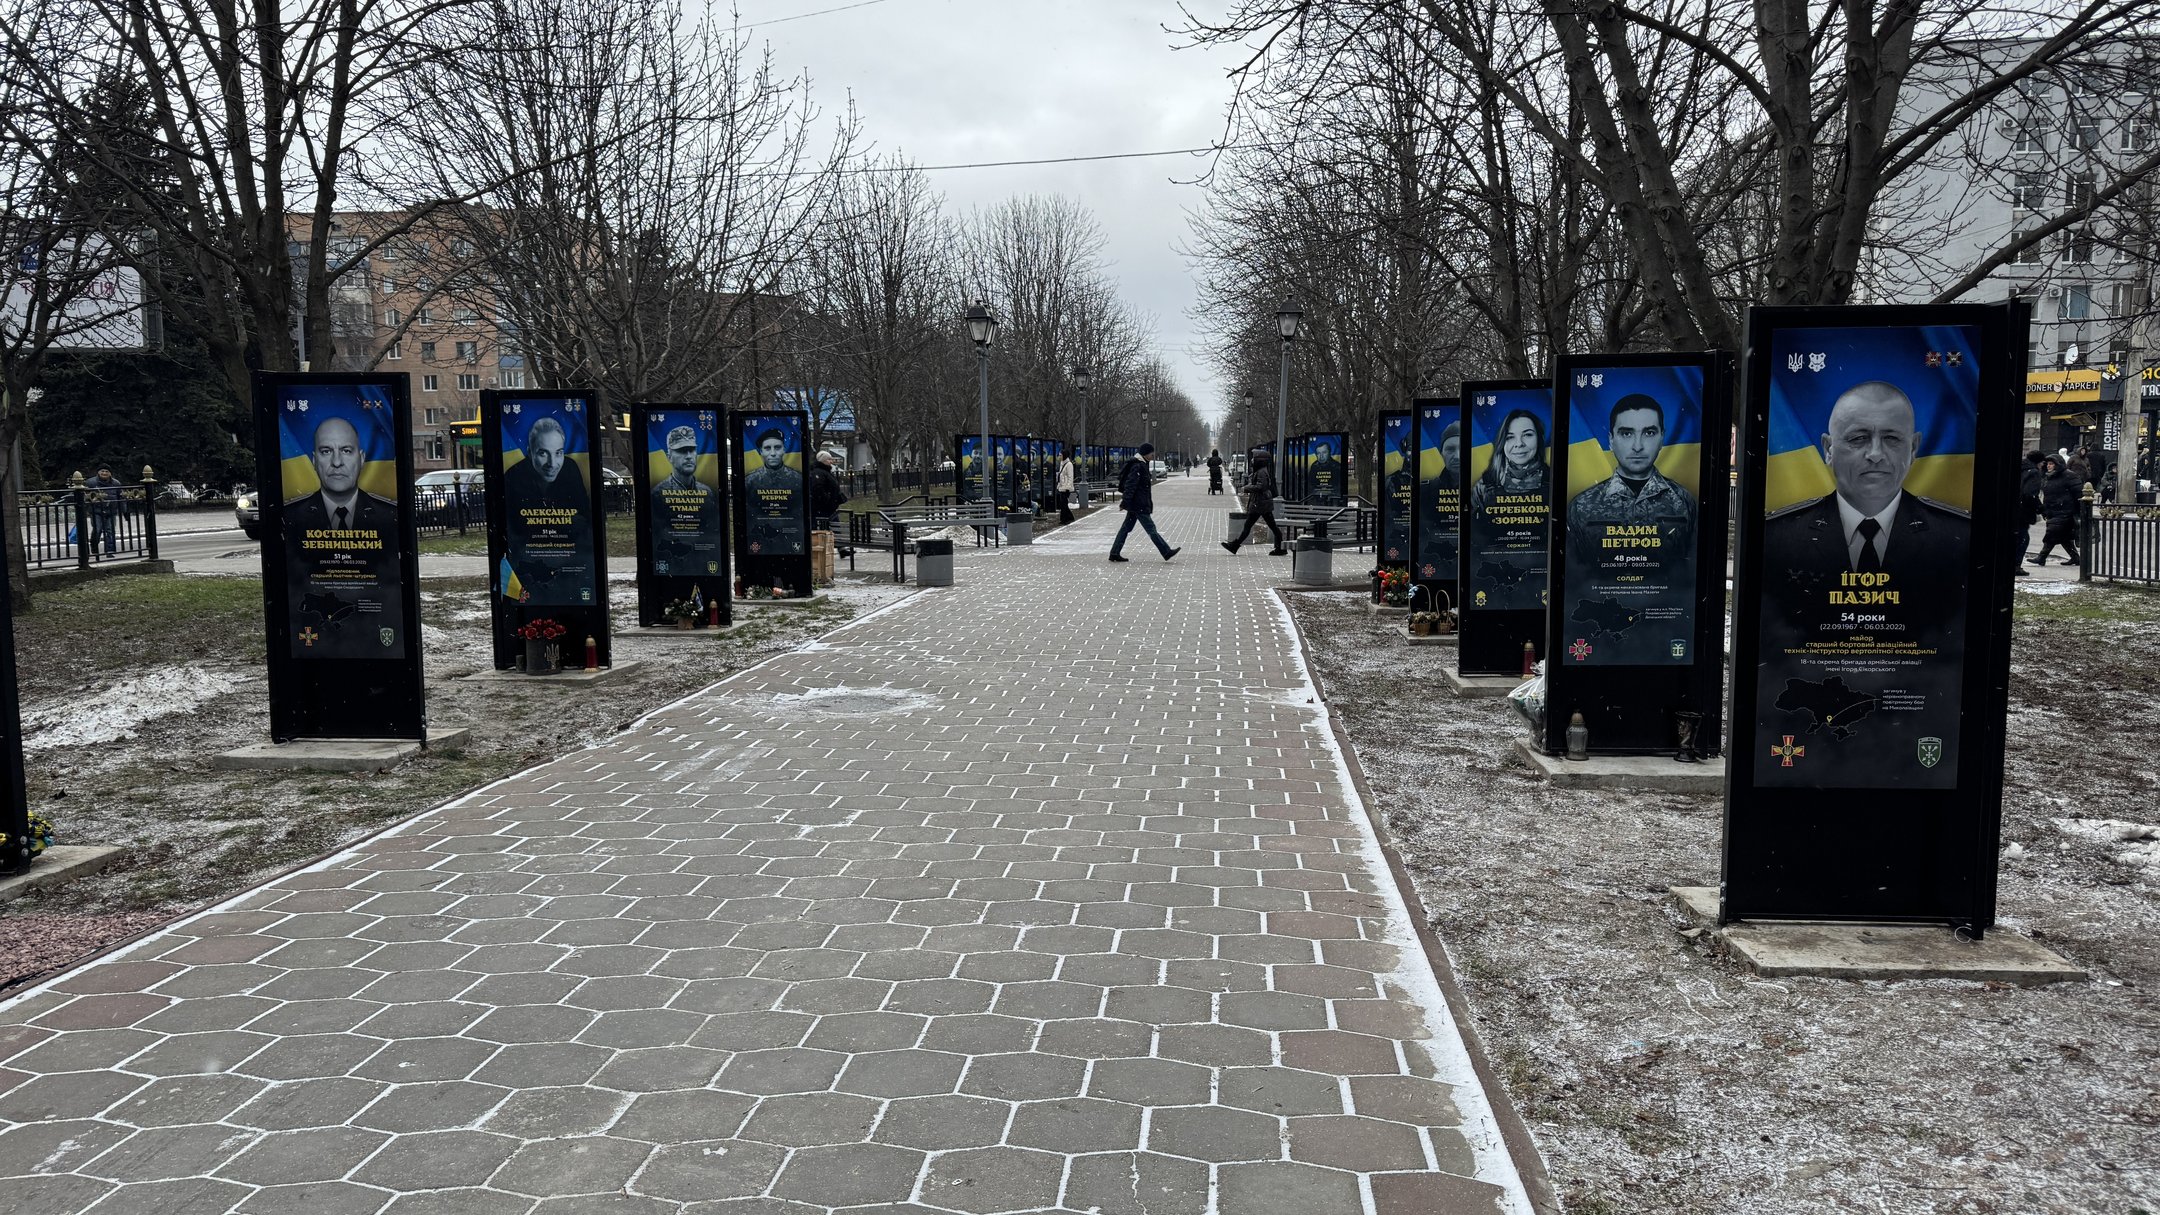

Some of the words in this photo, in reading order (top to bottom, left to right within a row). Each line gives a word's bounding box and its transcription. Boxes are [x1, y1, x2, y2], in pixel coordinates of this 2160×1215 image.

[1496, 494, 1542, 503] НАТАЛІЯ
[520, 508, 577, 516] ОЛЕКСАНДР
[1486, 505, 1550, 514] СТРЕБКОВА
[1492, 516, 1544, 524] «ЗОРЯНА»
[306, 530, 378, 538] КОСТЯНТИН
[1606, 525, 1657, 536] ВАДИМ
[302, 540, 382, 550] ЗЕБНИЦЬКИЙ
[1602, 537, 1661, 548] ПЕТРОВ
[1626, 555, 1648, 563] років
[1841, 571, 1890, 587] ІГОР
[1829, 590, 1900, 605] ПАЗИЧ
[1841, 612, 1855, 622] 54
[1857, 614, 1886, 623] роки
